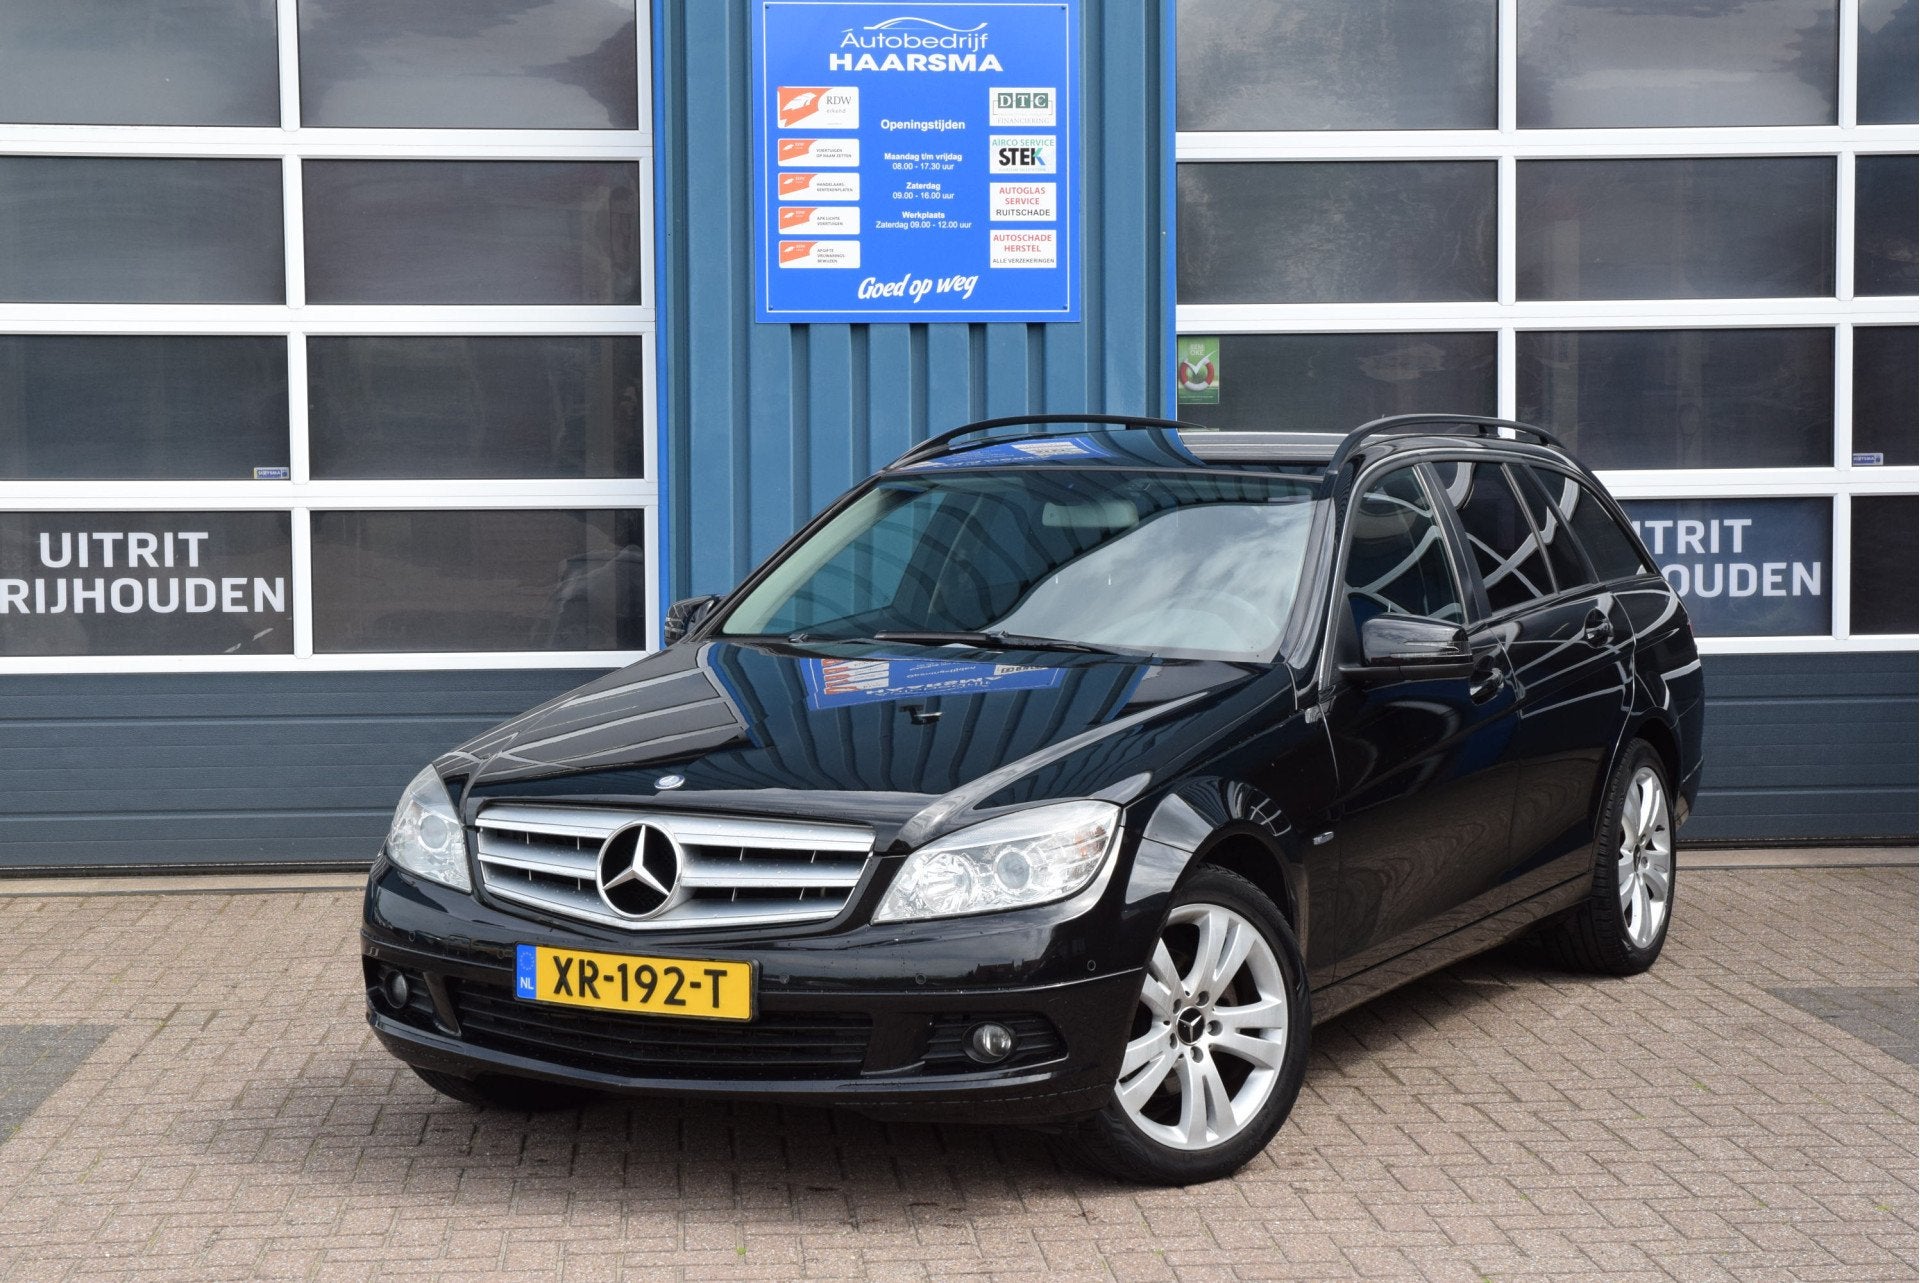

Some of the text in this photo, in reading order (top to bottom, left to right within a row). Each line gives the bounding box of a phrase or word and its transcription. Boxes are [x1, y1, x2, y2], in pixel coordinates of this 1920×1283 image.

[840, 32, 989, 53] Autobedrijf
[829, 53, 1004, 72] HAARSMA
[826, 96, 852, 105] RDW
[998, 94, 1047, 107] DTC
[880, 119, 966, 132] Openingstijden
[992, 139, 1055, 147] AIRCO SERVICE
[884, 152, 920, 162] Maandag
[935, 152, 963, 162] vrijdag
[998, 147, 1046, 166] STEK
[892, 162, 914, 170] 08.00
[920, 162, 941, 170] 17.30
[906, 182, 941, 191] Zaterdag
[999, 187, 1046, 195] AUTOGLAS
[1004, 197, 1040, 205] SERVICE
[901, 211, 946, 220] Werkplaats
[875, 221, 909, 230] Zaterdag
[993, 234, 1052, 242] AUTOSCHADE
[857, 273, 979, 304] Goed op weg
[1632, 519, 1752, 554] TRIT
[40, 532, 209, 568] UITRIT
[1661, 561, 1822, 597] OUDEN
[0, 577, 285, 614] RIJHOUDEN
[520, 978, 534, 990] NL
[552, 955, 728, 1009] XR-192-T
